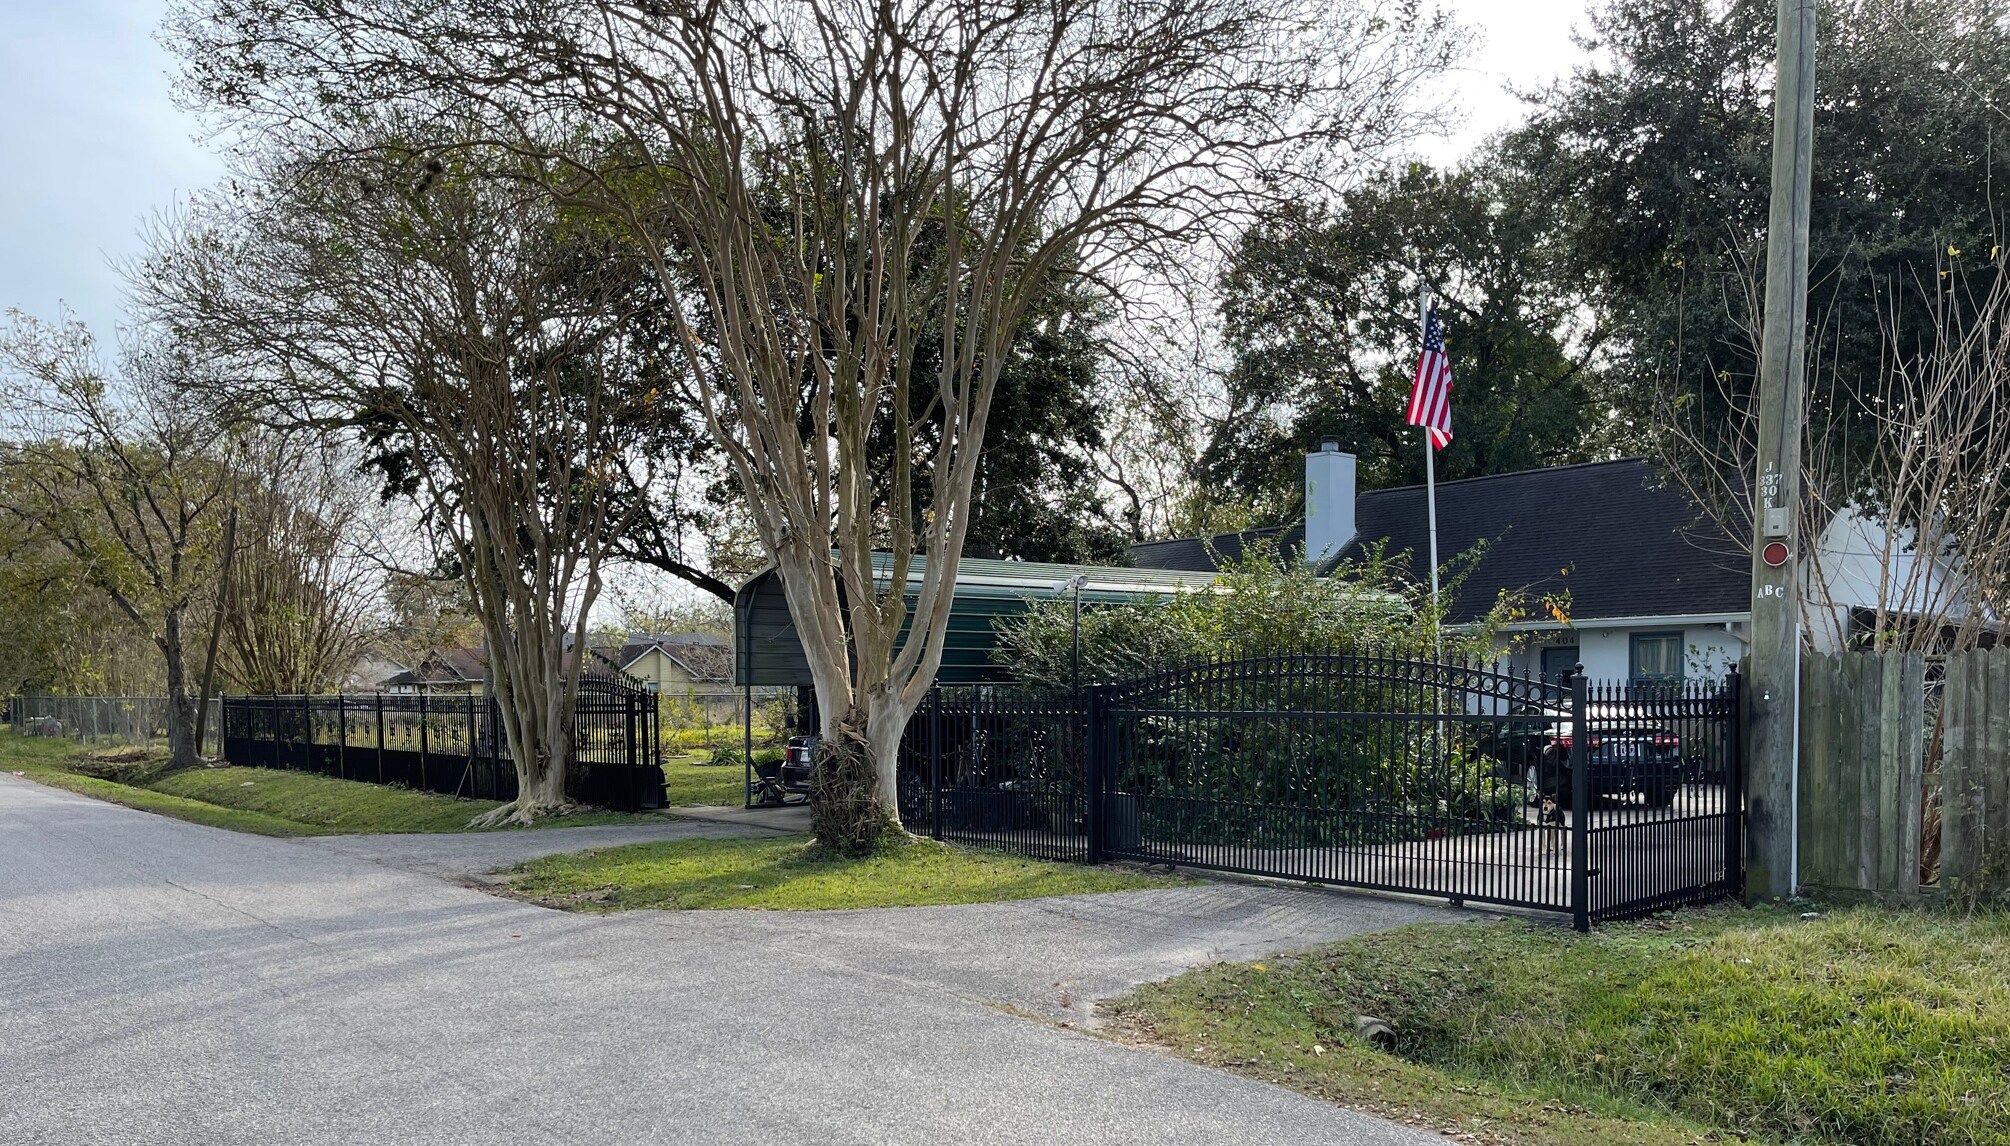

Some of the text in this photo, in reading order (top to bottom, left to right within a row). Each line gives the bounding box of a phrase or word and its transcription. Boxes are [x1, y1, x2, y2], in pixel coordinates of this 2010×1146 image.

[1765, 461, 1773, 473] J
[1760, 485, 1778, 497] 30
[1763, 497, 1773, 509] K
[1555, 636, 1575, 645] 404
